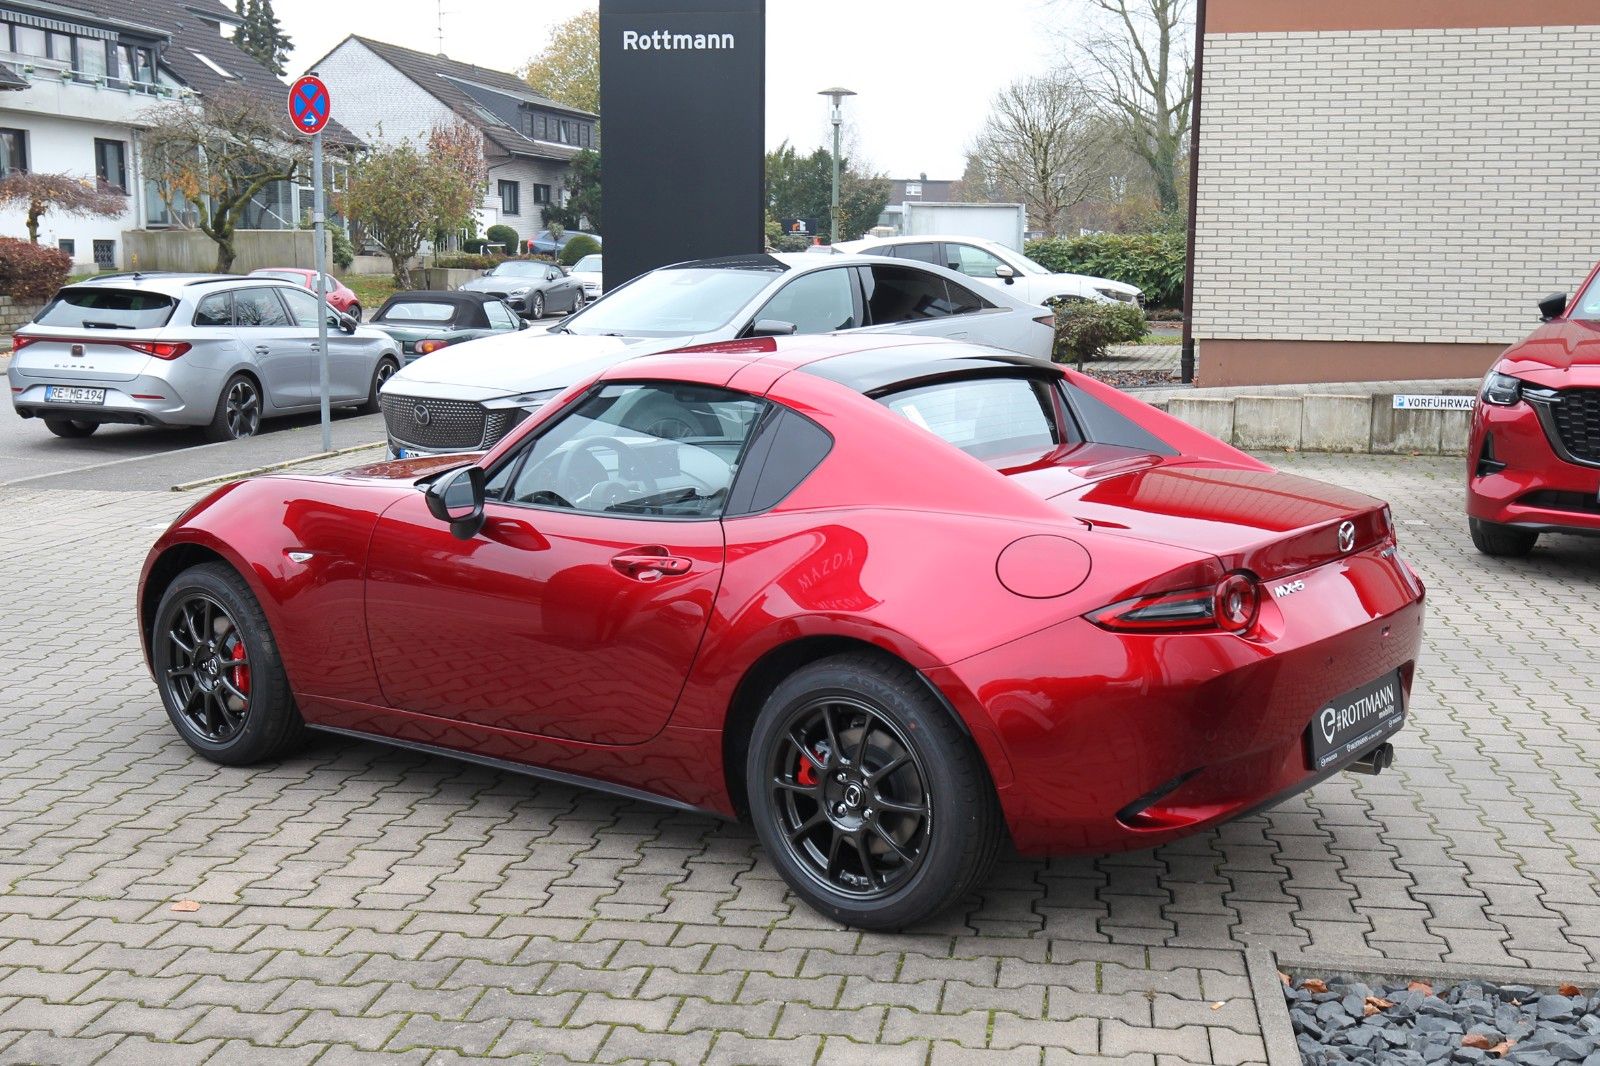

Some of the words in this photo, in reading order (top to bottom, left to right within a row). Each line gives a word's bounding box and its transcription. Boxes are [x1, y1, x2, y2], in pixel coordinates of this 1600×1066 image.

[623, 30, 735, 50] Rottmann
[52, 387, 64, 398] RE
[69, 388, 82, 400] MG
[84, 390, 103, 400] 194
[1274, 580, 1305, 598] MX-5
